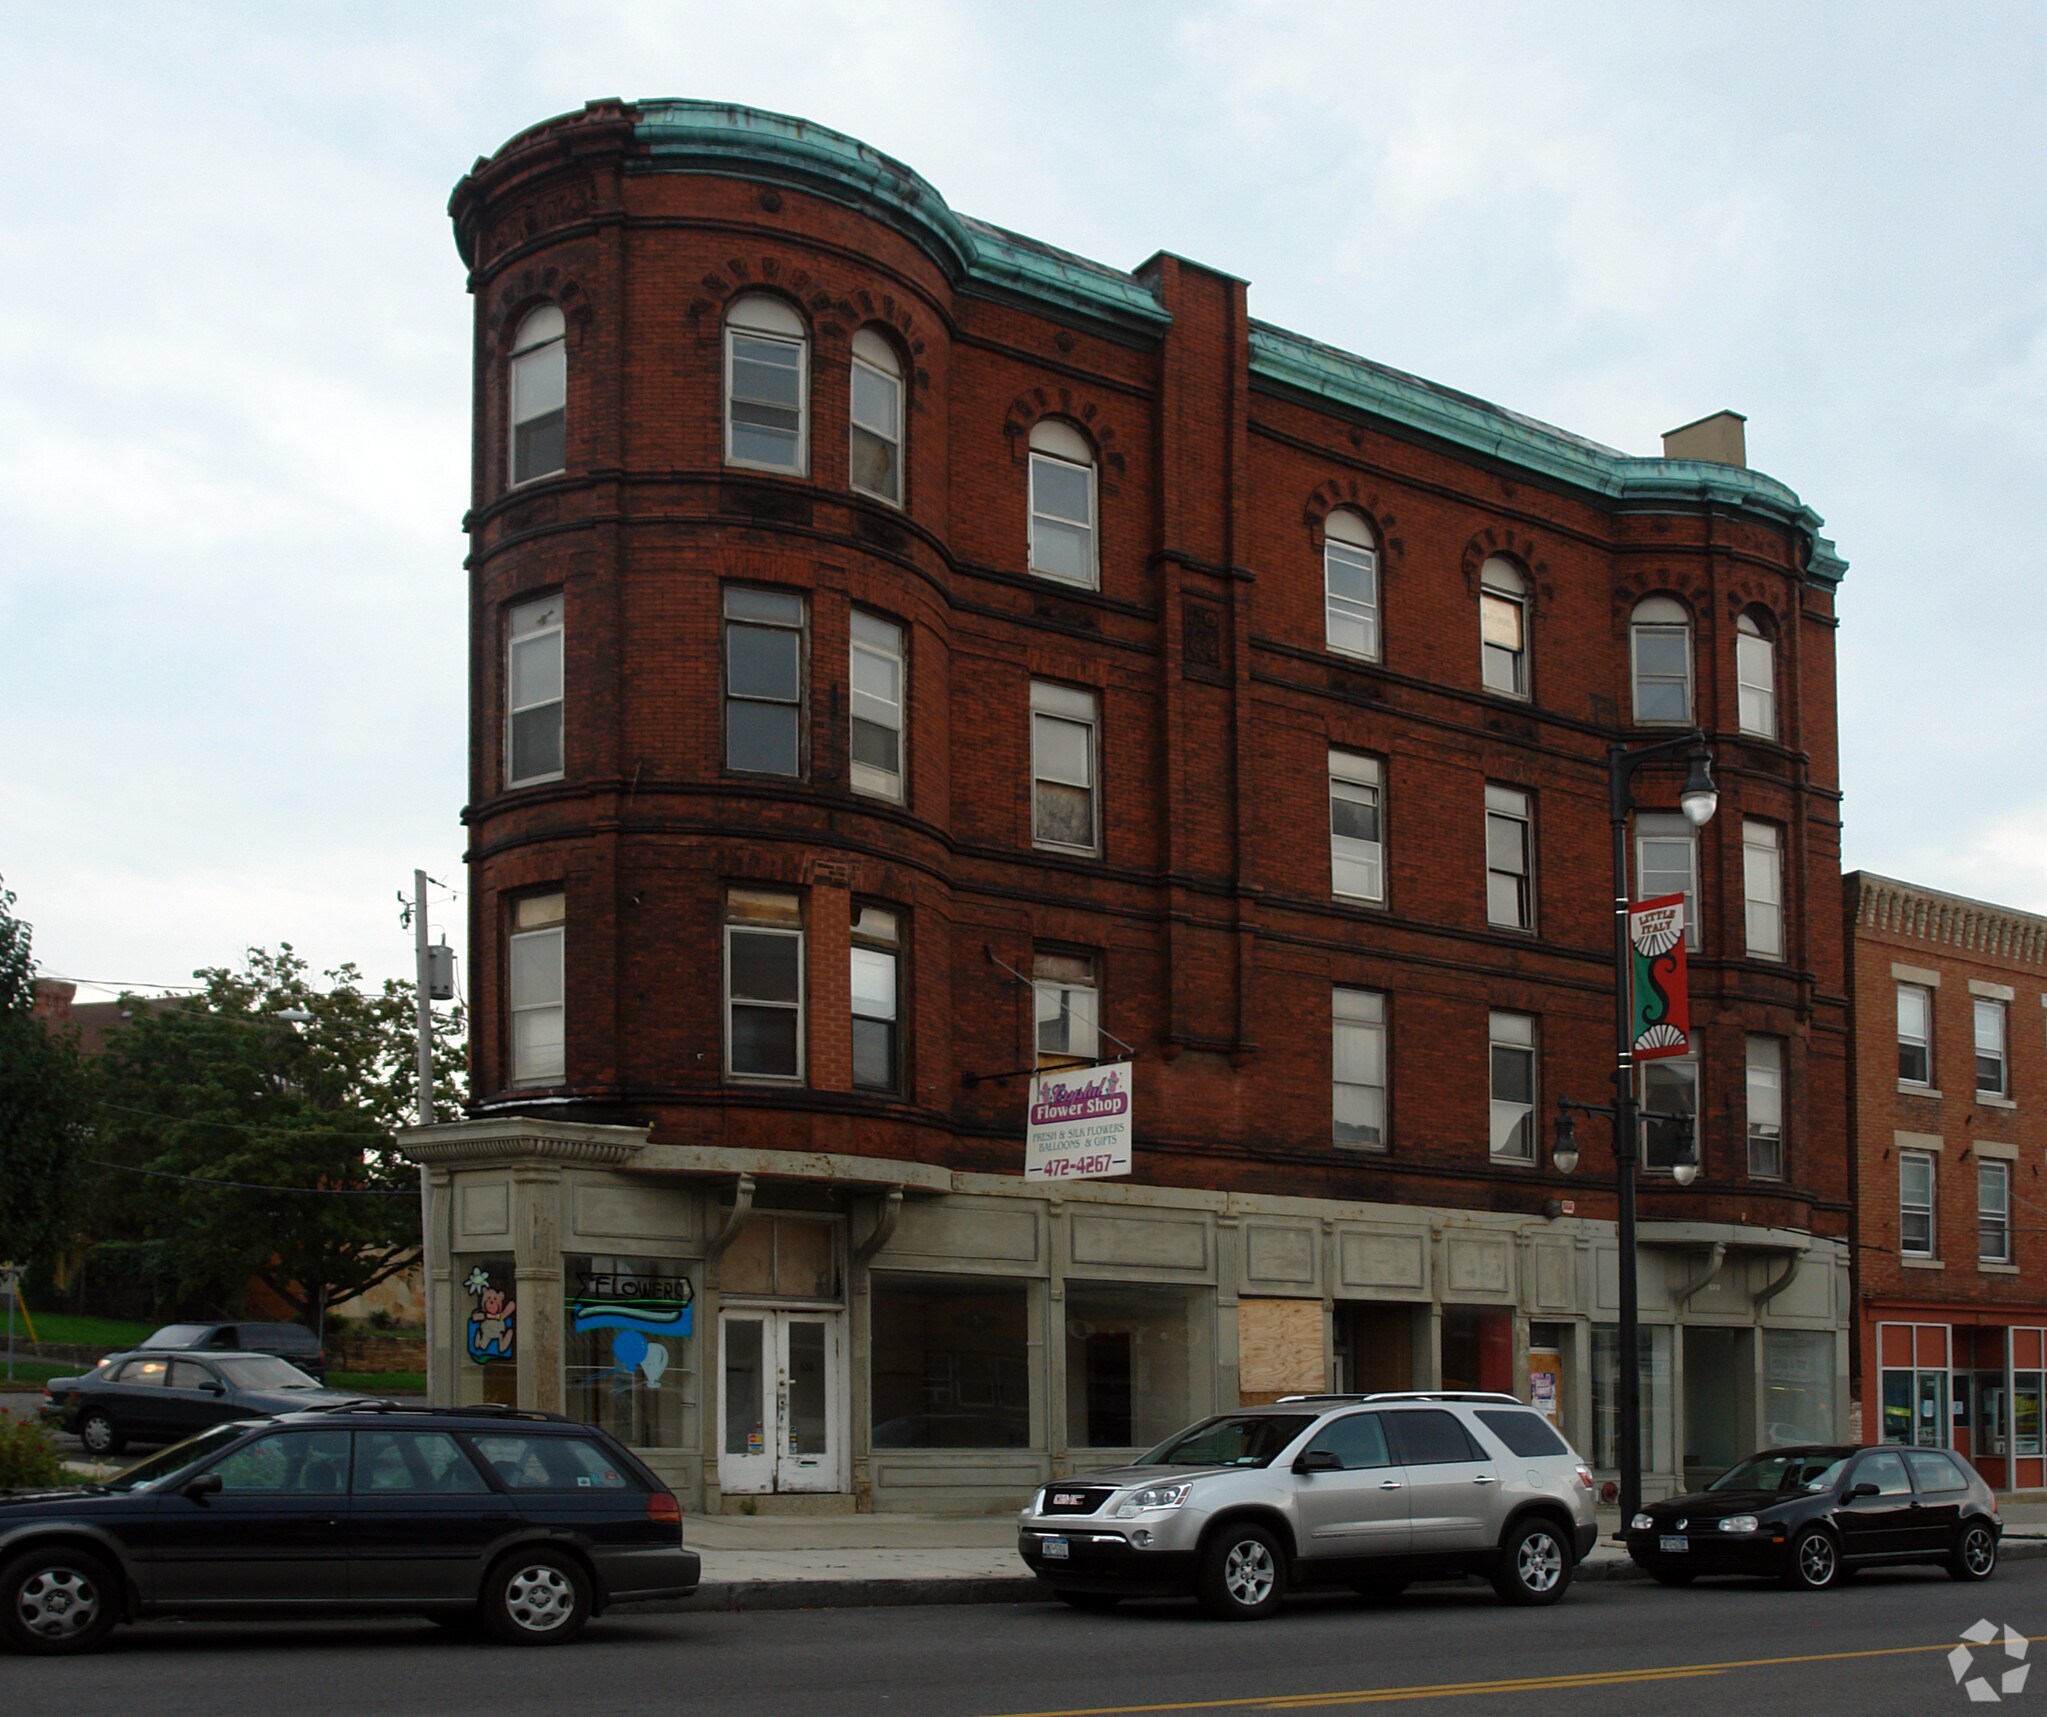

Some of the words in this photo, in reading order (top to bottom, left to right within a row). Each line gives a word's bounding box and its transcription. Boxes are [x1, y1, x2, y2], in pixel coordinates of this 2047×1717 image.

[1638, 909, 1676, 925] LITTLE
[1641, 920, 1672, 934] ITALY
[1037, 1103, 1083, 1120] Flower
[1087, 1097, 1122, 1114] Shop
[1033, 1131, 1057, 1142] FRESH
[1058, 1130, 1065, 1140] &
[1068, 1127, 1085, 1138] SILK
[1087, 1122, 1125, 1136] FLOWERS
[1039, 1139, 1080, 1152] BALLOONS
[1085, 1138, 1092, 1148] &
[1094, 1135, 1118, 1147] GIFTS
[1044, 1154, 1112, 1177] 472-4267
[591, 1276, 684, 1301] FLOWERS
[1053, 1494, 1085, 1505] GMC
